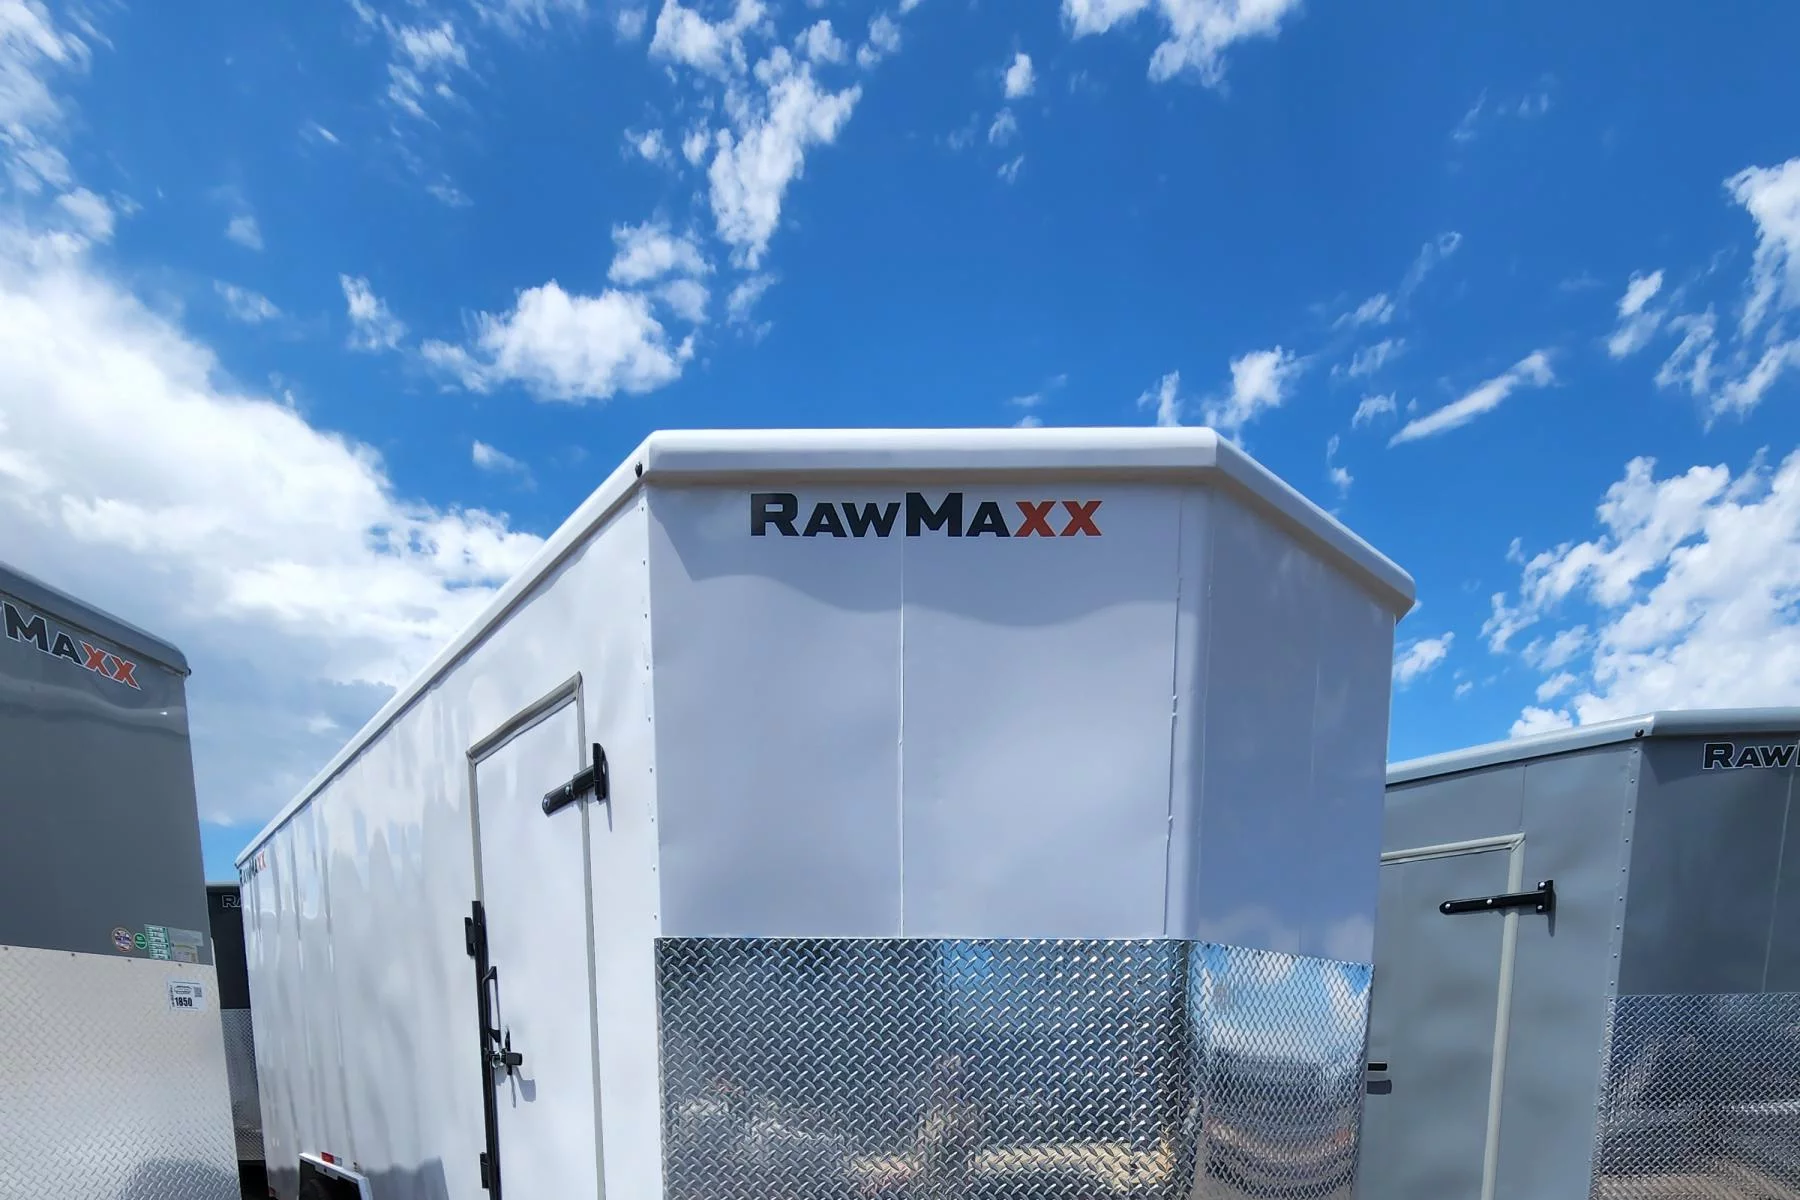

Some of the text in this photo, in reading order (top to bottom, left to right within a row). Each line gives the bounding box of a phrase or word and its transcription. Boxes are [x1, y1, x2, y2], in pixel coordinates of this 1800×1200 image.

[0, 600, 141, 690] MAXX
[1702, 741, 1800, 770] RAW
[174, 996, 193, 1007] 1850
